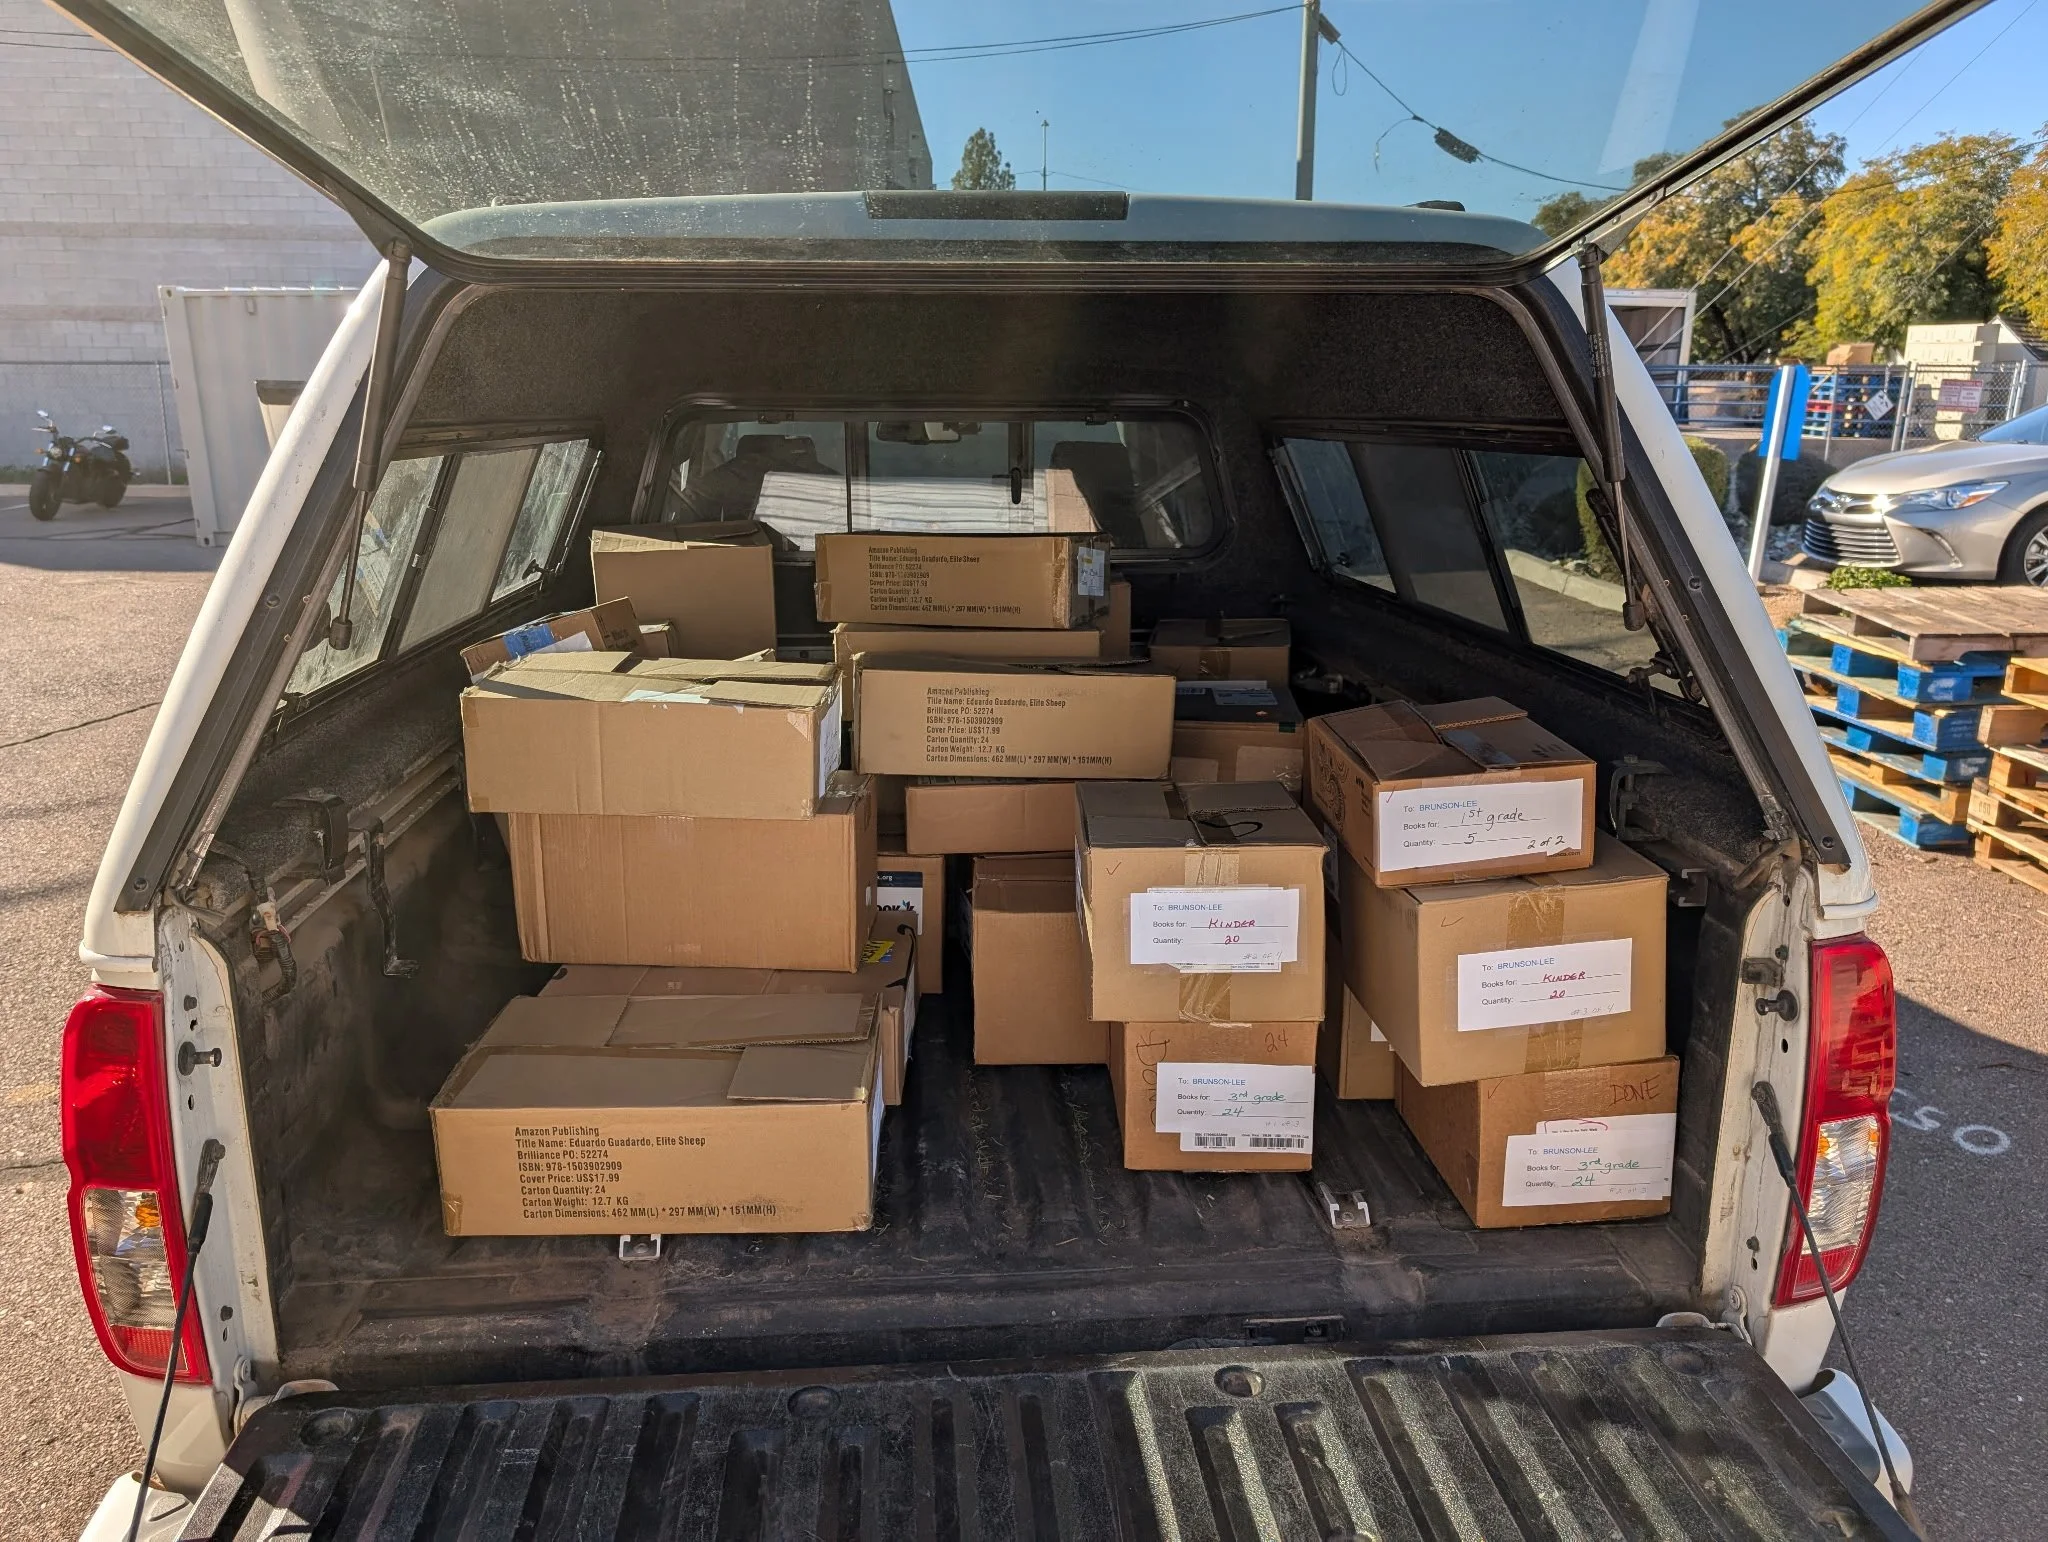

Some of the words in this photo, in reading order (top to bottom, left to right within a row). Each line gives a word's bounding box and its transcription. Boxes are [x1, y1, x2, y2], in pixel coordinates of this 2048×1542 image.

[890, 547, 917, 555] Publishing
[955, 688, 989, 697] Publishing
[995, 698, 1028, 707] Guadardo,
[1046, 699, 1065, 708] Sheep
[950, 736, 980, 744] Quantity:
[950, 745, 974, 754] Weight:
[1005, 756, 1026, 764] MM(L)
[1048, 756, 1070, 765] MM(W)
[1078, 756, 1112, 765] 151MM(H)
[1419, 801, 1478, 811] BRUNSON-LEE
[1404, 822, 1424, 830] Books
[1461, 809, 1483, 824] 1st
[1486, 808, 1524, 831] grade
[1404, 839, 1435, 848] Quantity:
[1464, 832, 1478, 844] 5
[1527, 839, 1536, 849] 2
[1540, 837, 1552, 846] of
[1555, 836, 1565, 845] 2
[1209, 918, 1255, 929] KINDER
[1225, 935, 1240, 944] 20
[1498, 958, 1554, 969] BRUNSON-LEE
[1504, 979, 1517, 987] for:
[1543, 972, 1586, 983] KINDER
[1482, 997, 1513, 1006] Quantity:
[1550, 990, 1566, 999] 20
[1265, 1030, 1288, 1052] 24
[1609, 1075, 1660, 1106] DONE
[1228, 1091, 1248, 1101] 3rd
[1254, 1093, 1286, 1104] grade
[1222, 1107, 1244, 1117] 24
[515, 1126, 550, 1137] Amazon
[552, 1126, 599, 1138] Publishing
[516, 1139, 537, 1148] Title
[540, 1138, 567, 1148] Name:
[569, 1137, 606, 1147] Eduardo
[607, 1137, 653, 1148] Guadardo,
[656, 1136, 676, 1146] Elite
[679, 1136, 706, 1147] Sheep
[517, 1150, 561, 1160] Brilliance
[563, 1150, 579, 1159] PO:
[580, 1149, 609, 1159] 52274
[518, 1162, 543, 1172] ISBN:
[546, 1161, 622, 1171] 978-1503902909
[1578, 1158, 1602, 1171] 3rd
[1601, 1160, 1640, 1174] grade
[520, 1173, 544, 1183] Cover
[547, 1173, 574, 1183] Price:
[576, 1172, 620, 1183] US$17.99
[1526, 1180, 1556, 1188] Quantity:
[1571, 1174, 1595, 1186] 24
[521, 1185, 550, 1195] Carton
[553, 1185, 593, 1197] Quantity:
[595, 1185, 606, 1194] 24
[522, 1197, 552, 1207] Carton
[554, 1197, 588, 1209] Weight:
[592, 1196, 612, 1206] 12.7
[616, 1196, 629, 1206] KG
[523, 1209, 552, 1219] Carton
[554, 1208, 610, 1218] Dimensions:
[611, 1207, 628, 1218] 462
[630, 1207, 659, 1219] MM(L)
[669, 1207, 685, 1216] 297
[687, 1206, 720, 1218] MM(W)
[729, 1205, 776, 1217] 151MM(H)
